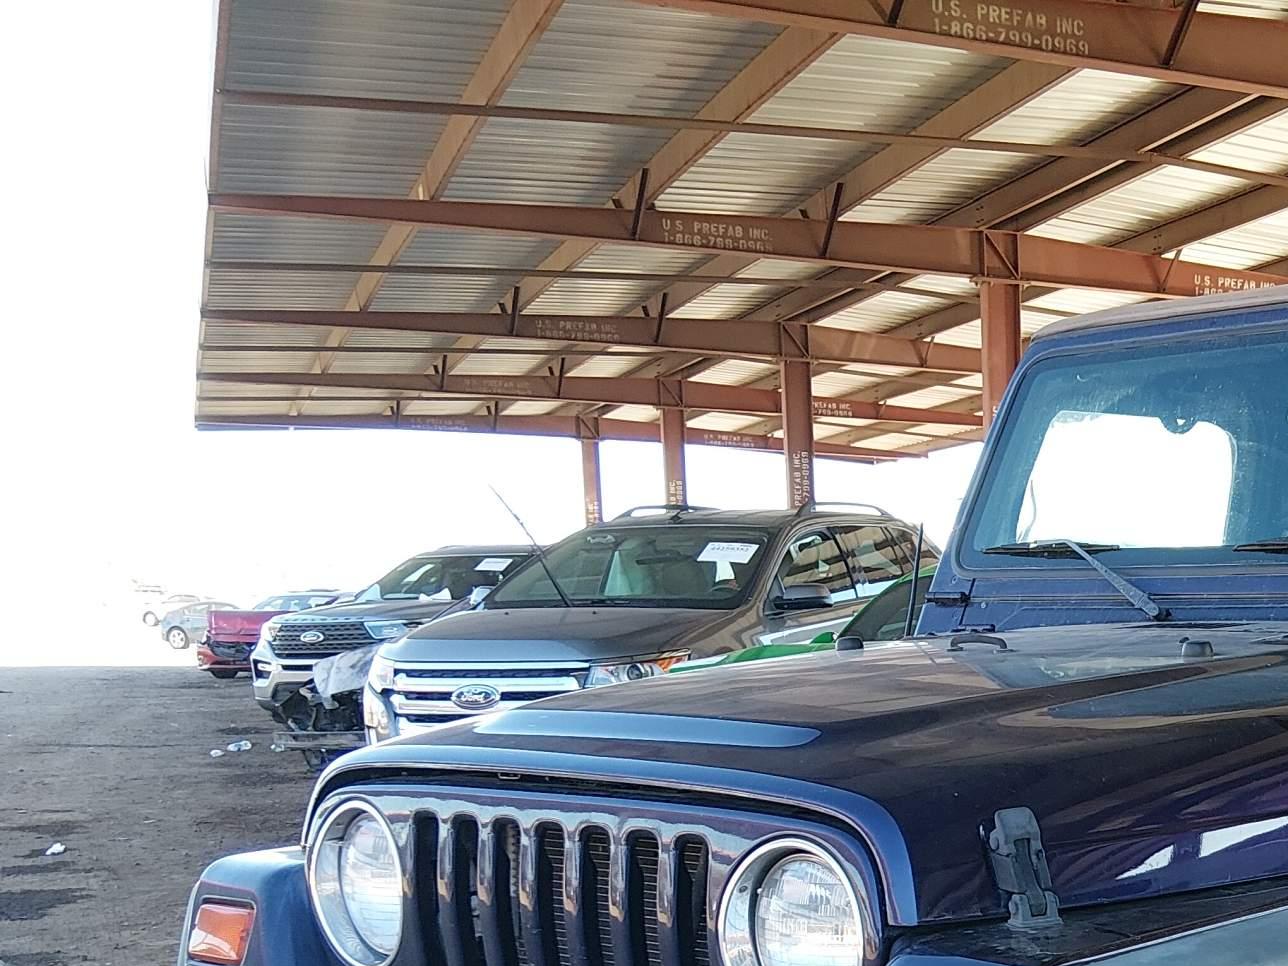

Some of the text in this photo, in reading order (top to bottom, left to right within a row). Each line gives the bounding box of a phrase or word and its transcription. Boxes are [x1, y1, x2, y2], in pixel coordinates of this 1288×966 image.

[977, 5, 1046, 28] PREFAB
[1056, 16, 1084, 36] INC
[694, 221, 743, 237] PREFAB
[1194, 274, 1214, 287] U.S.
[1218, 277, 1256, 289] PREFAB
